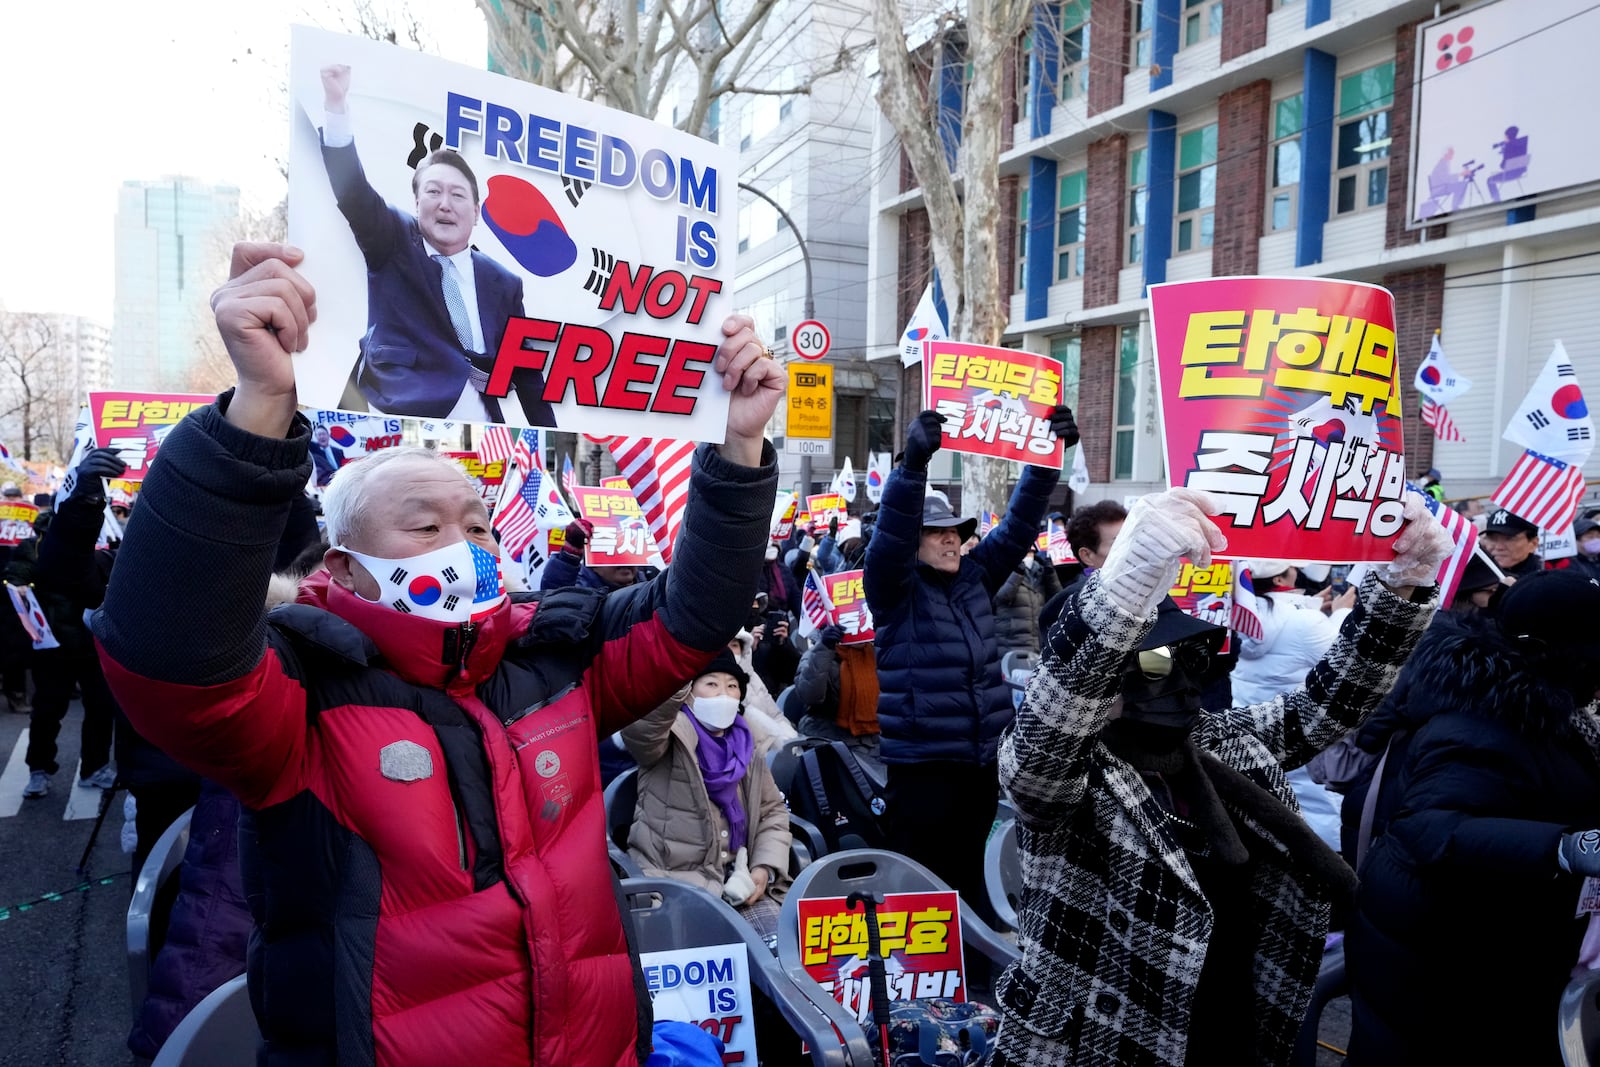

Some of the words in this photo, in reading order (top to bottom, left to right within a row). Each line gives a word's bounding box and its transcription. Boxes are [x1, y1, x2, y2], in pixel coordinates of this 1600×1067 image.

[445, 91, 719, 215] FREEDOM
[675, 216, 718, 268] IS
[599, 261, 723, 325] NOT
[800, 332, 823, 349] 30
[485, 316, 718, 416] FREE
[1179, 307, 1401, 418] 탄핵무
[931, 353, 1060, 406] 탄핵무효
[101, 399, 207, 429] 탄핵
[317, 410, 379, 423] FREE
[791, 396, 827, 409] 단속중
[384, 420, 400, 432] IS
[935, 399, 1058, 455] 즉시석방
[365, 434, 403, 452] NOT
[799, 441, 824, 453] 100m
[1168, 562, 1233, 598] 탄핵
[529, 732, 546, 743] MUST
[546, 728, 555, 737] DO
[804, 907, 953, 966] 탄핵무효
[643, 958, 734, 990] EDOM
[708, 988, 736, 1013] IS
[690, 1015, 742, 1044] OT
